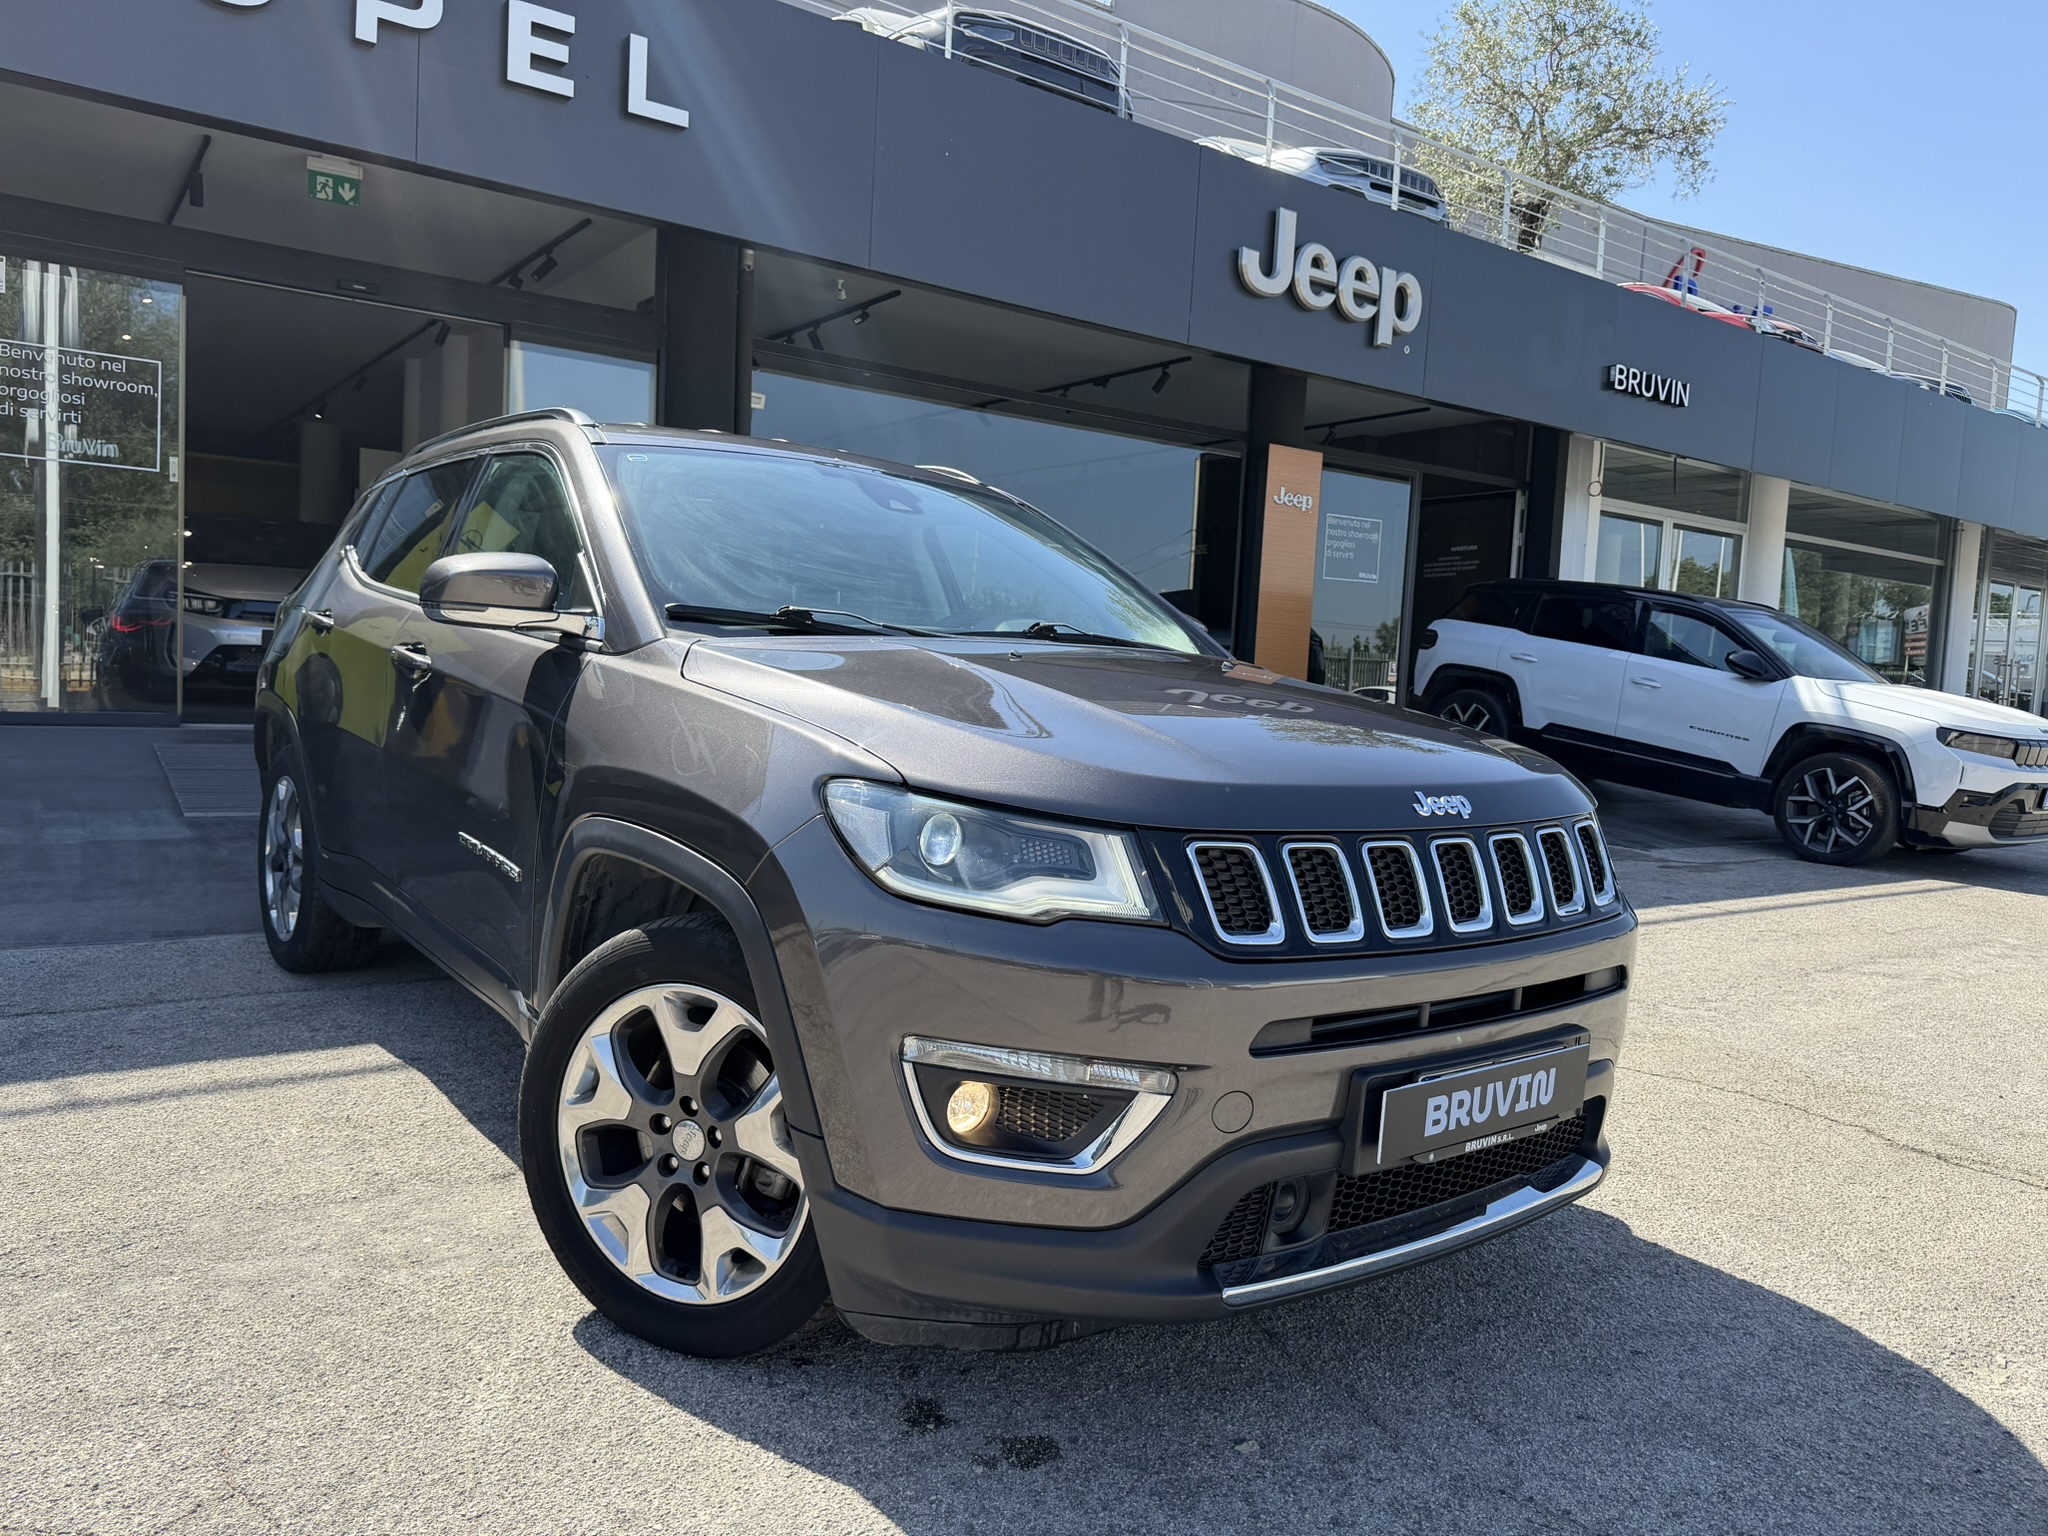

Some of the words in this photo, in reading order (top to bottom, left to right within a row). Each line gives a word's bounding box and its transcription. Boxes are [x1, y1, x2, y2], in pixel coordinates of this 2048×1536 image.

[1238, 206, 1423, 349] Jeep
[0, 343, 96, 369] Benvenuto
[101, 359, 126, 373] nel
[0, 365, 56, 384] nostro
[62, 371, 158, 398] showroom,
[0, 385, 85, 405] orgogliosi
[1615, 363, 1690, 407] BRUVIN
[0, 401, 14, 416] di
[19, 406, 82, 424] servirti
[1273, 486, 1313, 512] Jeep
[1412, 790, 1472, 819] Jeep
[1424, 1067, 1557, 1138] BRUVIN
[1534, 1123, 1548, 1132] Jeep
[1465, 1135, 1498, 1152] BRUVIN
